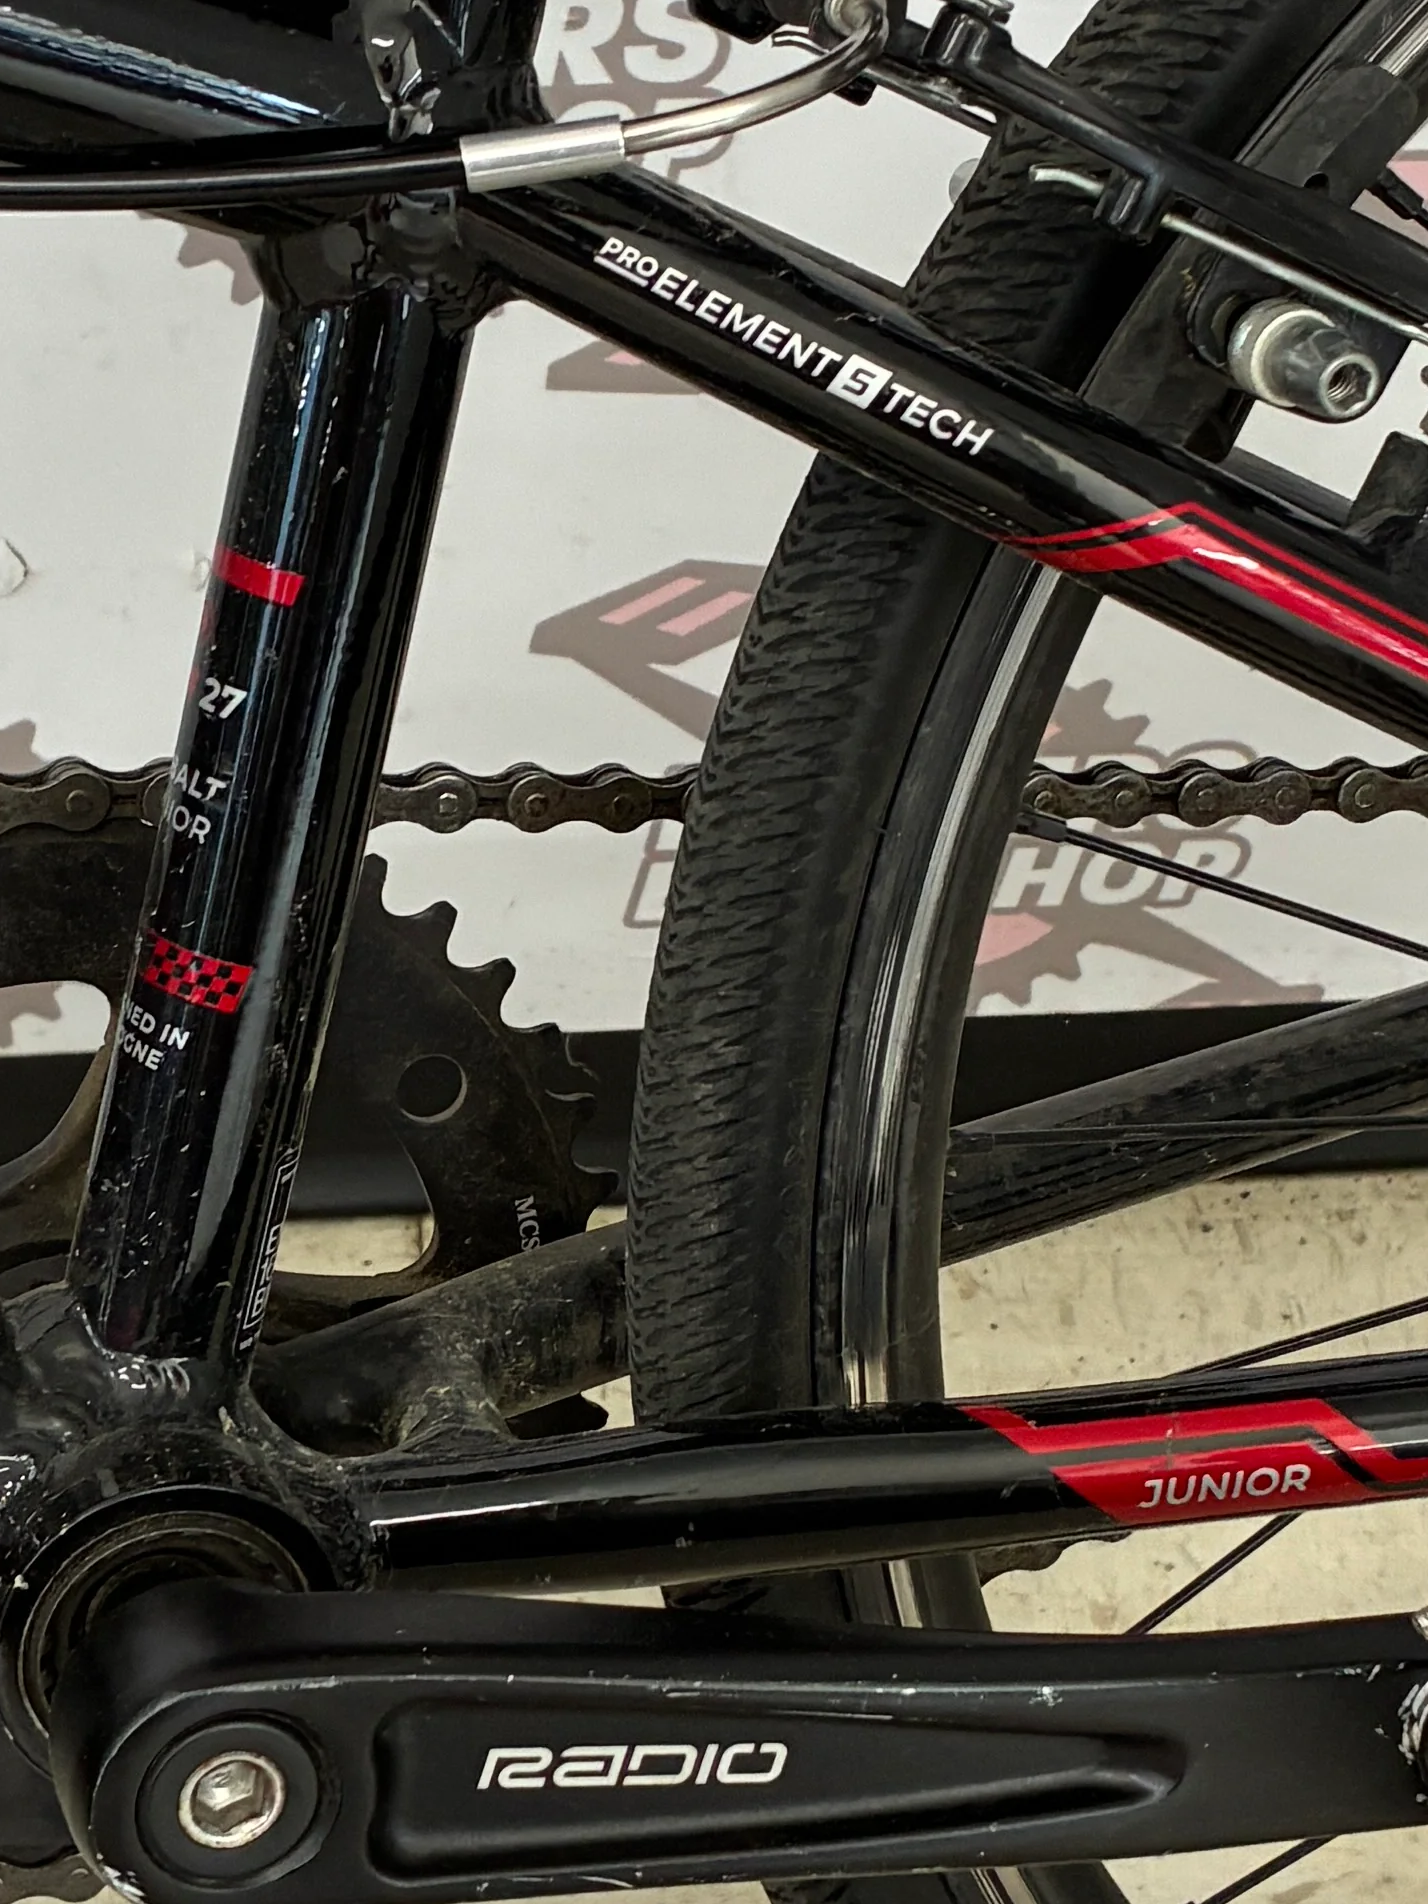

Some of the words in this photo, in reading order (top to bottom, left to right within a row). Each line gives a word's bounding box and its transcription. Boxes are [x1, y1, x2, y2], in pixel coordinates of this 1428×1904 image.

[601, 237, 659, 280] PRO
[650, 266, 844, 378] ELEMENT
[882, 382, 995, 456] TECH
[990, 838, 1242, 910] HOP
[159, 1023, 191, 1051] IN
[1137, 1461, 1313, 1511] JUNIOR
